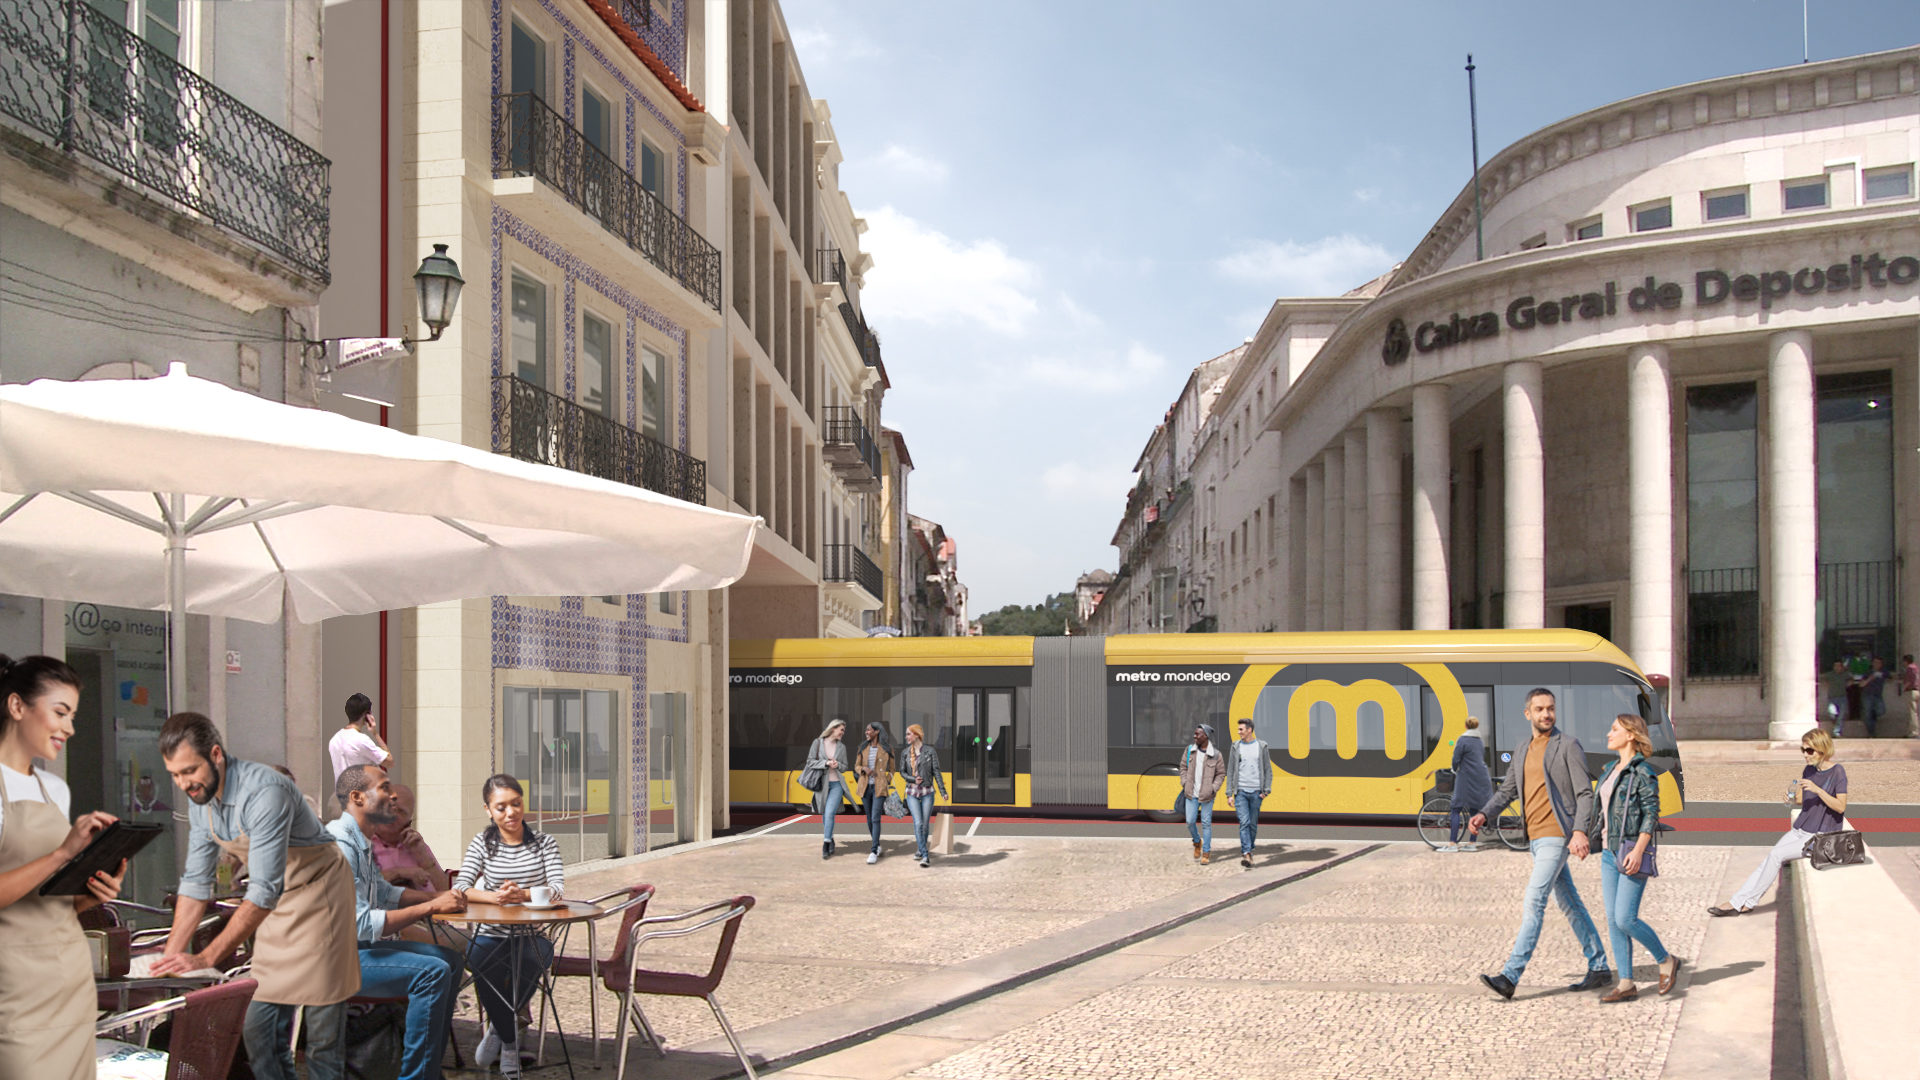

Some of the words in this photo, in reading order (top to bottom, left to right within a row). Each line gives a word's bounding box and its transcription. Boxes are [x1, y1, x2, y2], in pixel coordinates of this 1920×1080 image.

[1414, 310, 1500, 354] Caixa
[1506, 281, 1617, 331] Geral
[1628, 276, 1683, 312] de
[745, 672, 803, 685] mondego
[1116, 670, 1161, 682] metro
[1164, 670, 1231, 684] mondego
